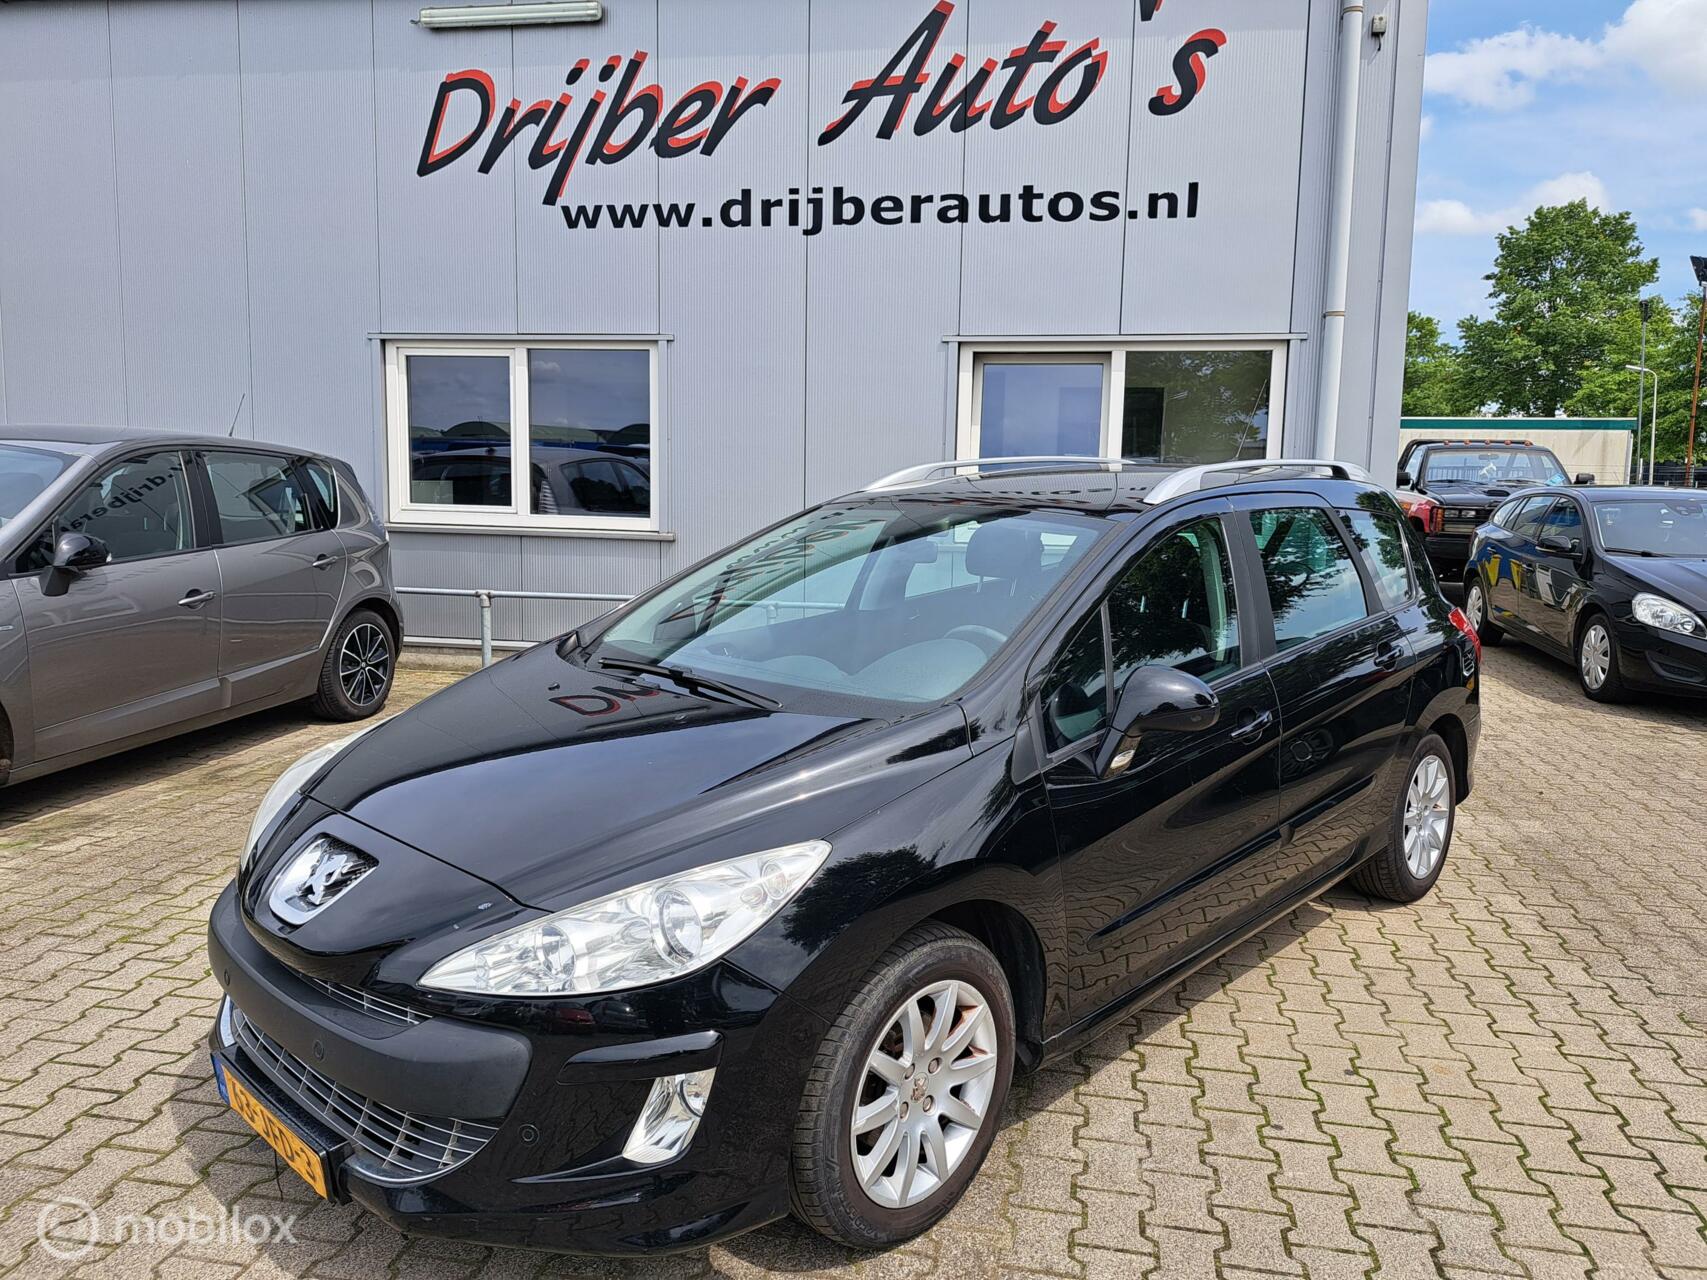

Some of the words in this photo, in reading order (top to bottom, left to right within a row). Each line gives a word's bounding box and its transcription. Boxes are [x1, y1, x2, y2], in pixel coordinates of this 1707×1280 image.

[417, 51, 781, 206] Drijber
[561, 181, 1199, 236] www.drijberautos.nl
[232, 1080, 317, 1182] 63-JFD-3
